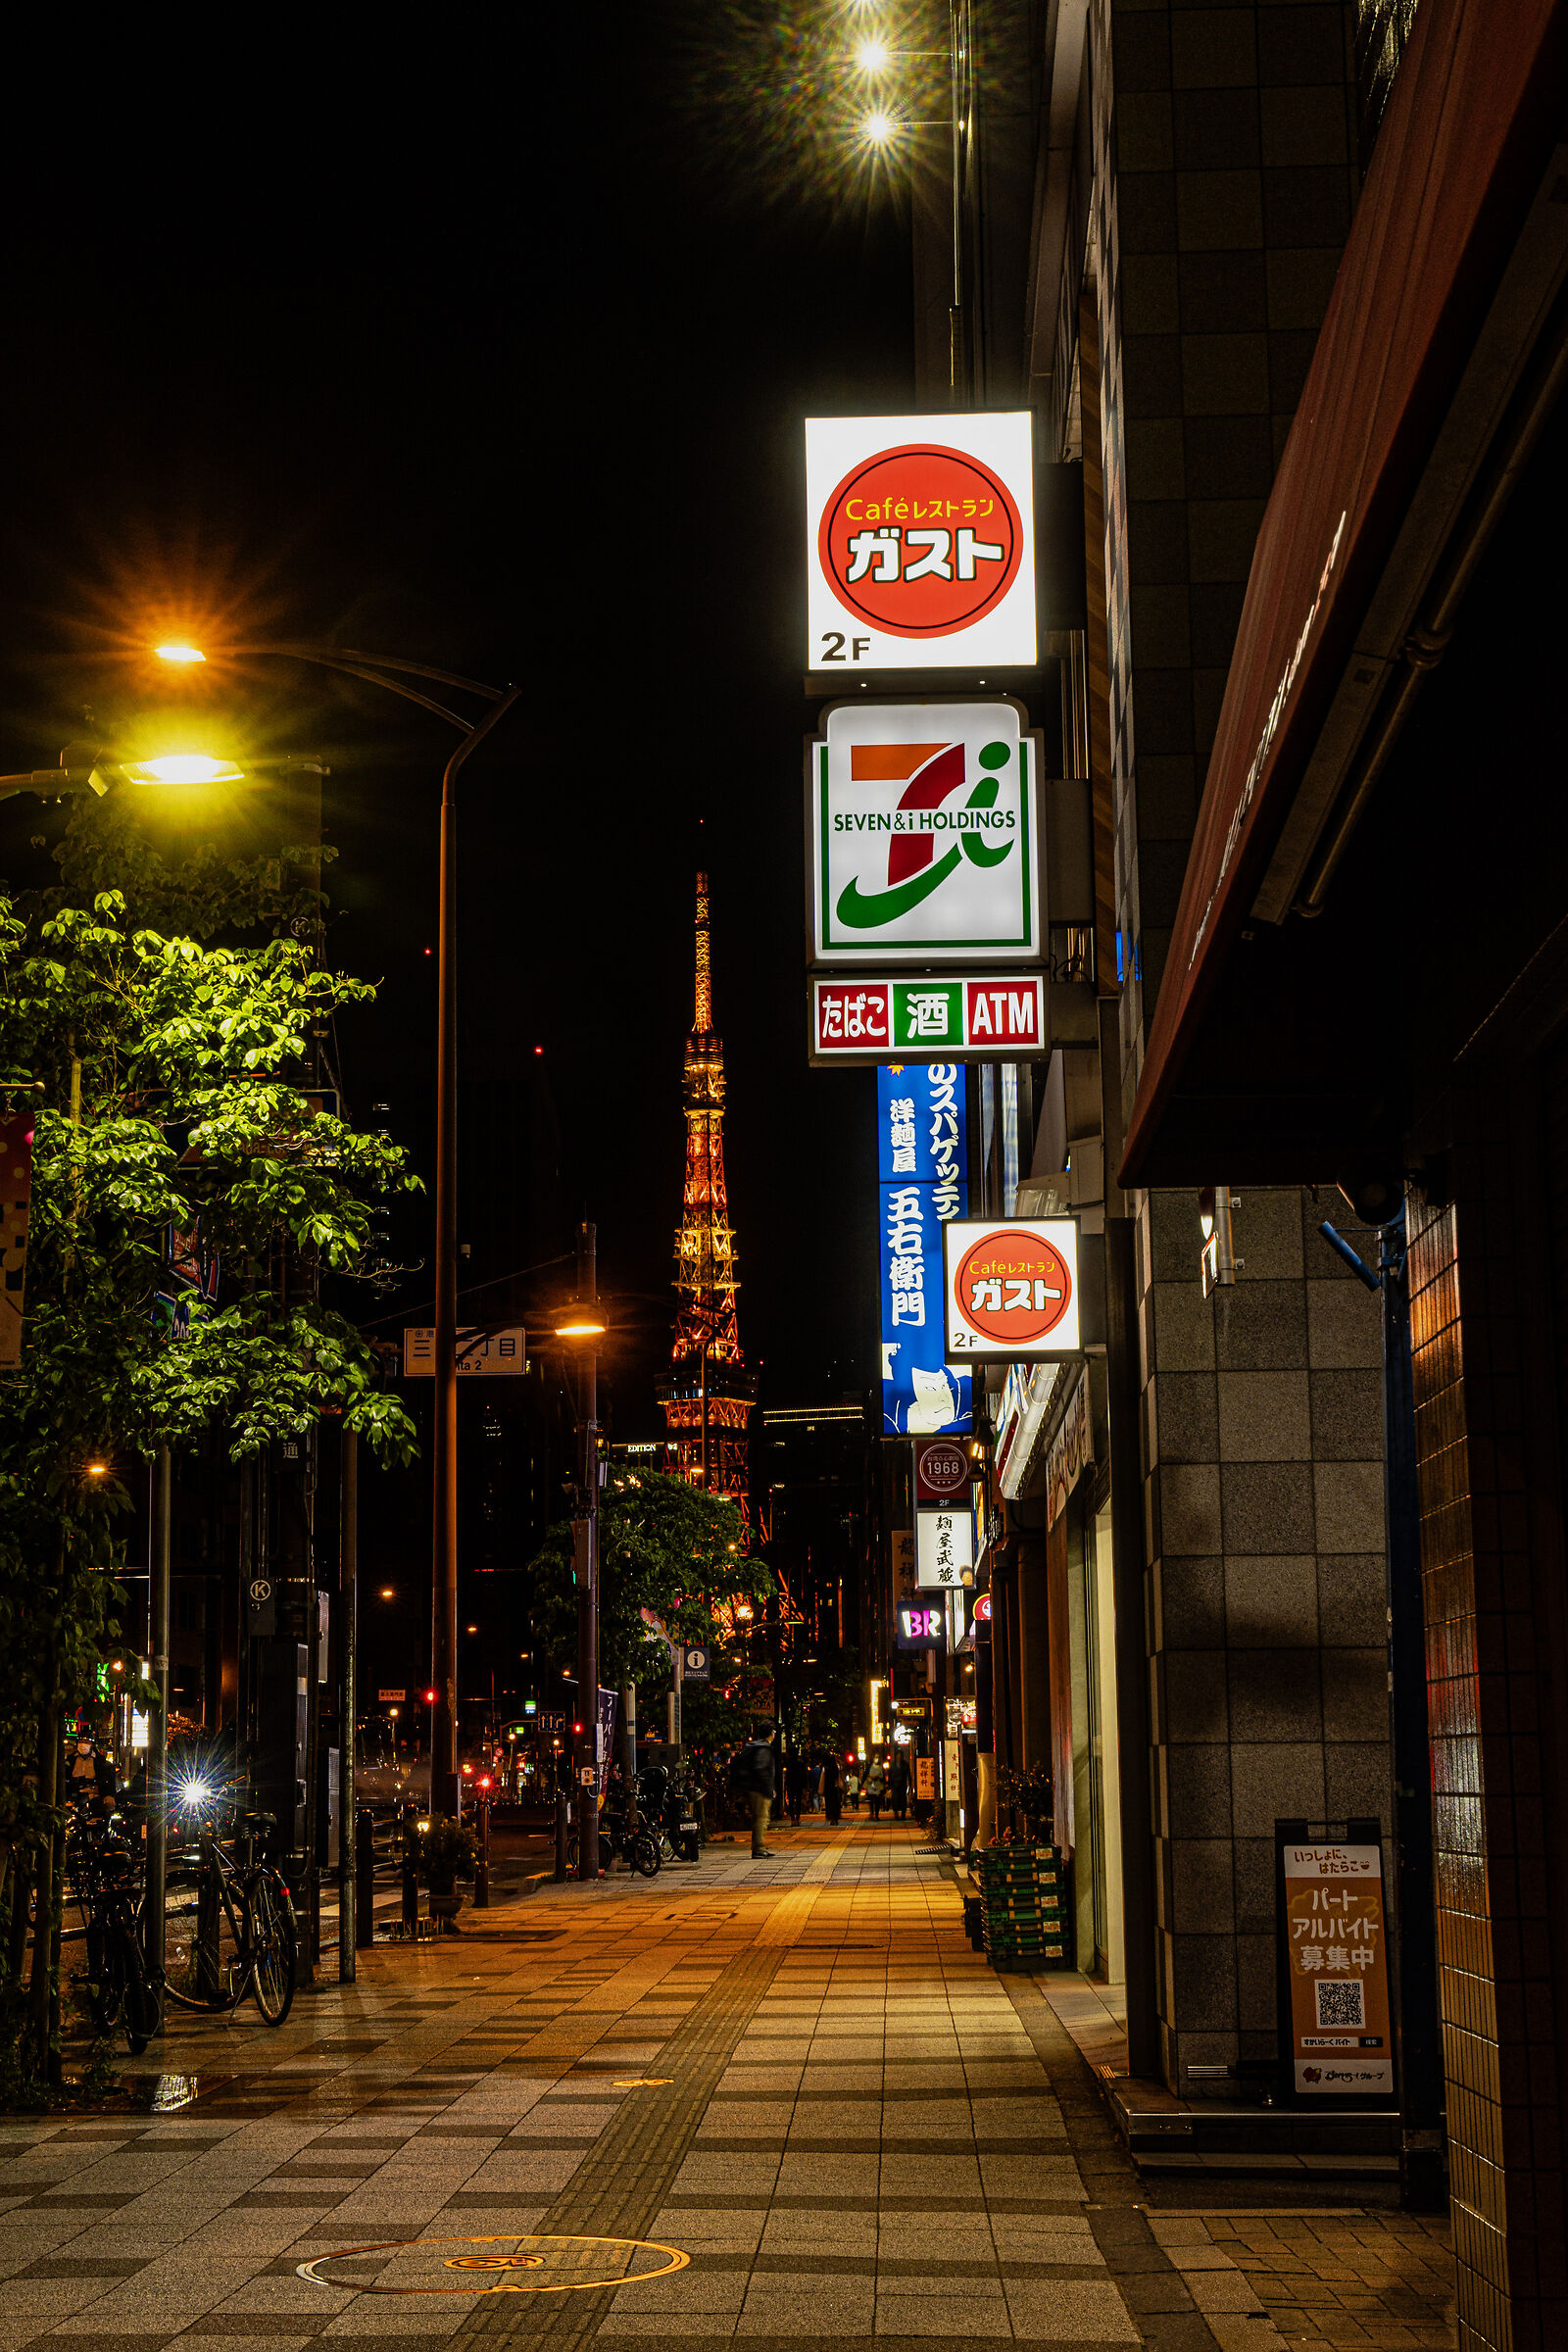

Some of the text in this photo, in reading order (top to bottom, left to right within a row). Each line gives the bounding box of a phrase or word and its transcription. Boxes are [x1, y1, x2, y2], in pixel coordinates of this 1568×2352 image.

[846, 526, 1004, 583] ガスト
[820, 632, 871, 662] 2F
[920, 809, 1016, 830] HOLDINGS
[821, 994, 887, 1039] たばこ
[906, 993, 950, 1039] 酒
[972, 992, 1034, 1035] ATM
[886, 1186, 926, 1327] 五右衛門
[970, 1277, 1061, 1311] ガスト
[954, 1332, 978, 1348] 2F
[471, 1359, 482, 1371] 2
[627, 1444, 657, 1452] EDITION
[927, 1461, 959, 1475] 1968
[1312, 1887, 1358, 1911] パート
[1293, 1917, 1379, 1939] アルバイト
[1300, 1944, 1374, 1971] 募集中
